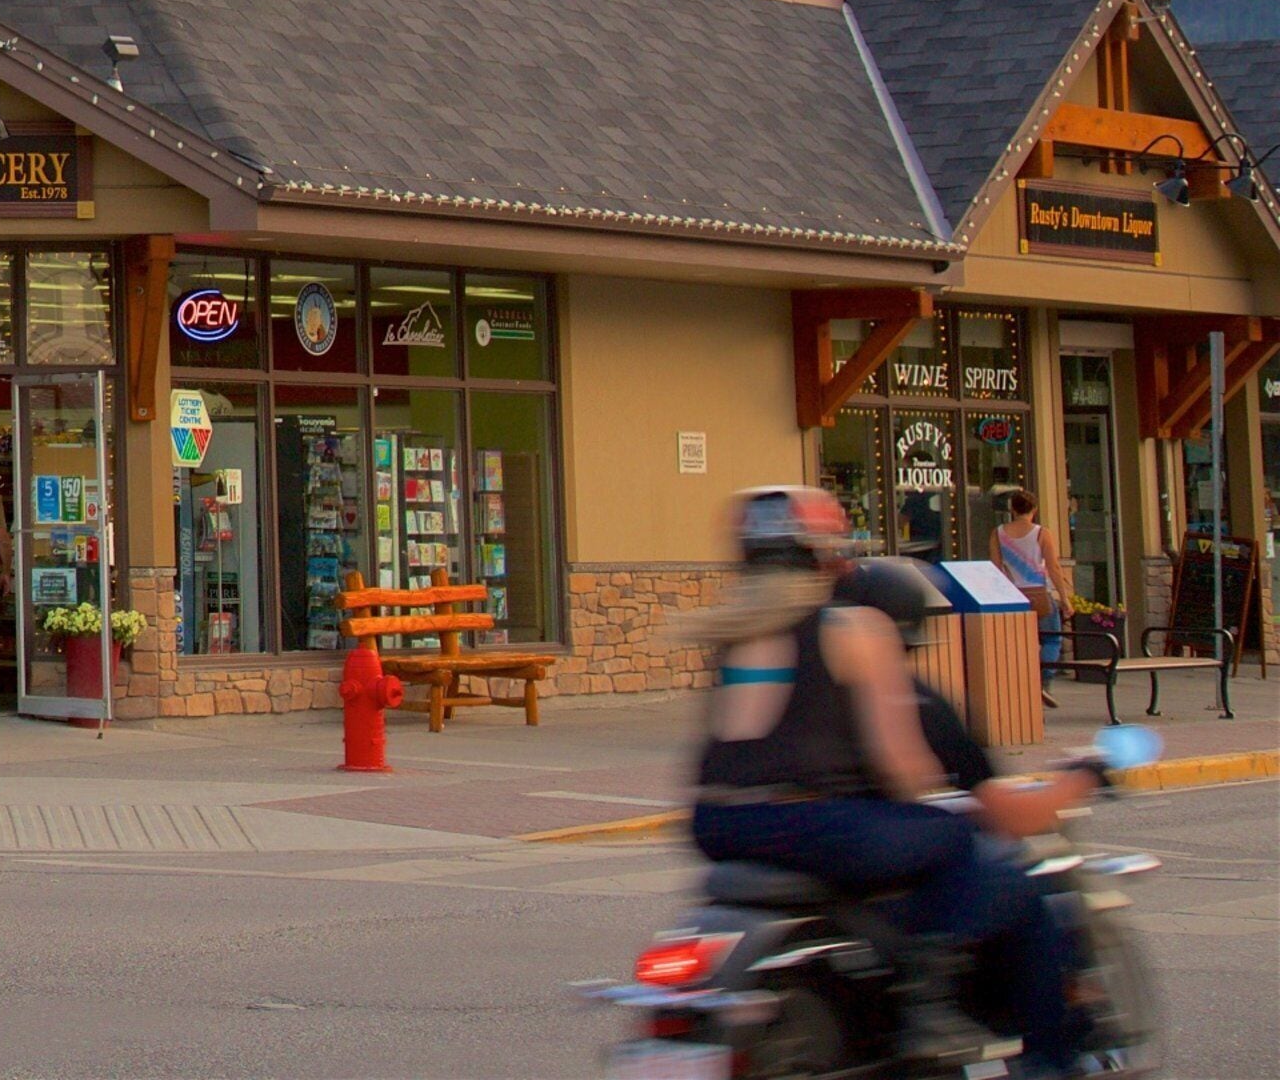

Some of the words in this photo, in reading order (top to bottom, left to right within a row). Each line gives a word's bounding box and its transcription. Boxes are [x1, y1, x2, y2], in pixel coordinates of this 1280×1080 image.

[20, 186, 68, 200] Est.1978
[1030, 202, 1069, 231] Rusty's
[1071, 206, 1120, 233] Downtown
[1123, 211, 1154, 238] Liquor
[182, 300, 237, 325] OPEN
[893, 363, 948, 388] WINE
[964, 367, 1018, 392] SPIRITS
[178, 399, 202, 408] LOTTERY
[180, 407, 200, 416] TICKET
[179, 416, 202, 425] CENTRE
[896, 422, 952, 462] RUSTY'S
[897, 467, 954, 493] LIQUOR
[181, 526, 191, 576] FASHION
